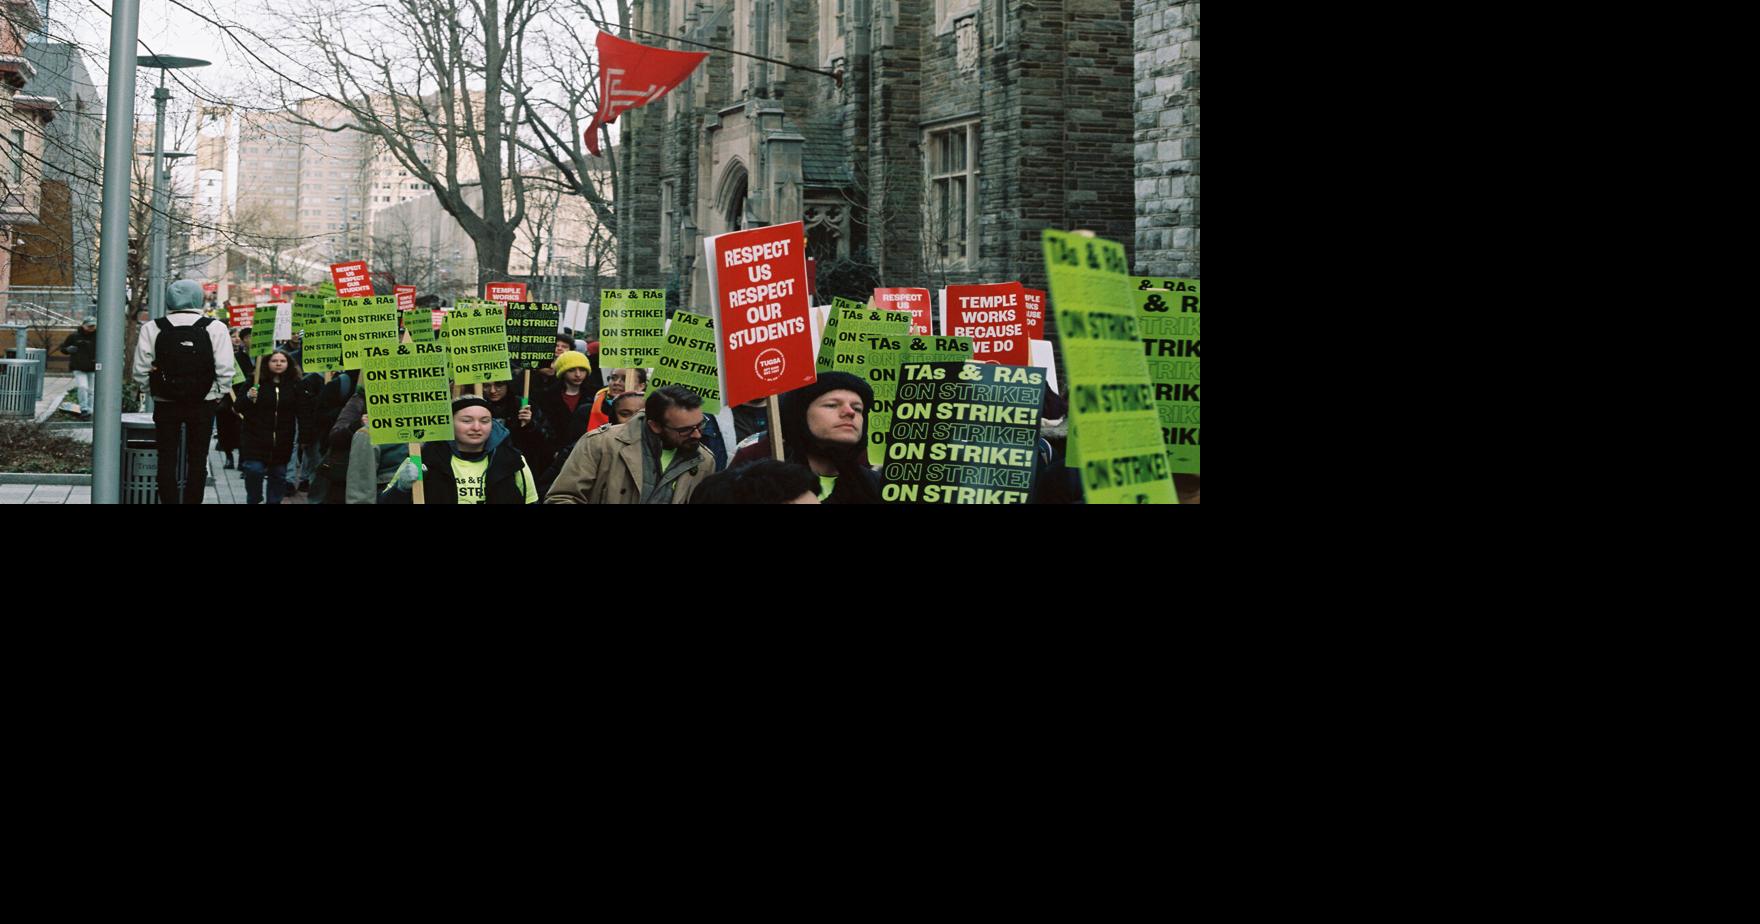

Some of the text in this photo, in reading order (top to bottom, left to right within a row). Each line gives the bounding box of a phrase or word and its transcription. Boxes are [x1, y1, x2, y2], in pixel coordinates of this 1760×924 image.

[724, 239, 791, 268] RESPECT
[1047, 236, 1080, 267] TAs
[335, 265, 362, 273] RESPECT
[748, 264, 772, 283] US
[338, 275, 365, 283] RESPECT
[1138, 279, 1197, 292] & RAs
[339, 285, 371, 294] STUDENTS
[603, 290, 663, 299] TAs & RAs
[728, 278, 795, 309] RESPECT
[342, 299, 358, 307] TAs
[363, 298, 373, 306] &
[376, 297, 395, 305] RAs
[882, 293, 923, 301] RESPECT
[958, 293, 1018, 309] TEMPLE
[1143, 294, 1169, 313] &
[450, 308, 503, 318] TAs & RAs
[508, 302, 526, 310] TAs
[529, 302, 538, 310] &
[542, 303, 558, 311] RAs
[602, 309, 663, 318] ON STRIKE!
[746, 303, 782, 324] OUR
[343, 316, 357, 324] ON
[358, 313, 395, 323] STRIKE!
[522, 319, 558, 327] STRIKE!
[677, 312, 714, 329] TAs &
[841, 310, 863, 320] TAs
[869, 311, 881, 321] &
[886, 312, 909, 322] RAs
[961, 309, 1017, 324] WORKS
[451, 325, 504, 337] ON STRIKE!
[1061, 309, 1087, 339] ON
[1141, 315, 1200, 335] TRIK
[344, 330, 397, 341] ON STRIKE!
[602, 328, 664, 337] ON STRIKE!
[729, 316, 805, 350] STUDENTS
[838, 332, 856, 342] ON
[954, 324, 1023, 339] BECAUSE
[507, 335, 557, 343] ON STRIKE!
[667, 334, 717, 353] ON STR
[823, 337, 836, 347] ON
[867, 337, 901, 350] TAs
[910, 337, 928, 350] &
[935, 338, 969, 352] RAs
[363, 343, 443, 357] TAs & RAs
[453, 343, 506, 355] ON STRIKE!
[602, 347, 660, 356] ON STRIKE
[993, 340, 1014, 353] DO
[1142, 338, 1200, 357] TRIK
[345, 350, 358, 359] ON
[837, 354, 853, 364] ON
[455, 361, 508, 373] ON STRIKE!
[659, 356, 718, 376] ON STRIK
[367, 367, 445, 381] ON STRIKE!
[869, 368, 896, 381] ON
[904, 364, 1042, 385] TAs & RAs
[369, 391, 448, 405] ON STRIKE!
[899, 383, 1040, 405] ON STRIKE!
[1075, 384, 1100, 415] ON
[1153, 383, 1200, 402] RIK
[871, 400, 894, 412] ON
[896, 402, 1038, 425] ON STRIKE!
[372, 415, 450, 429] ON STRIKE!
[892, 422, 1036, 446] ON STRIKE!
[889, 443, 1033, 467] ON STRIKE!
[468, 476, 476, 484] &
[885, 462, 1031, 489] ON STRIKE!
[1086, 459, 1112, 490] ON
[881, 484, 1029, 504] ON STRIKE!
